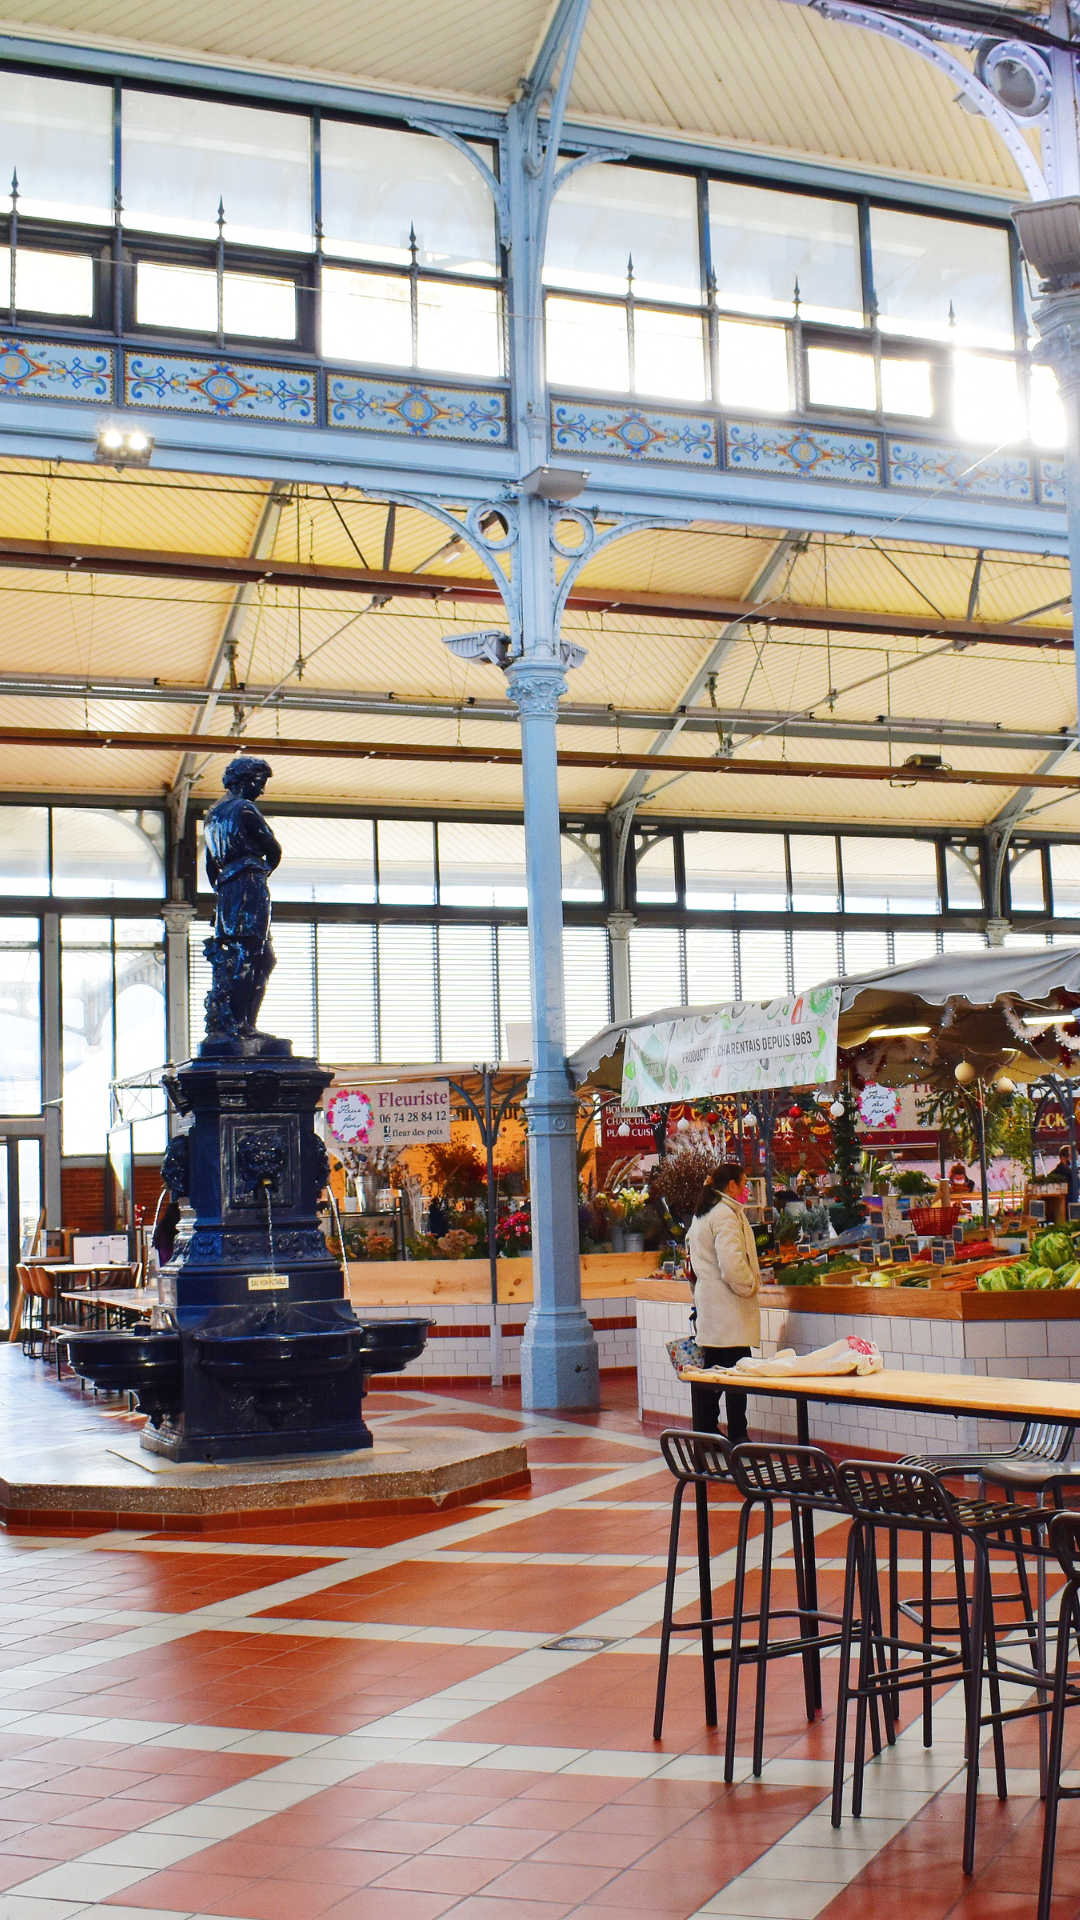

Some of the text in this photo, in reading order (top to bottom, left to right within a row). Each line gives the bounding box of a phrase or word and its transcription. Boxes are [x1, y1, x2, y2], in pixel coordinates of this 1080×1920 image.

[682, 1047, 717, 1064] PRODUCTEUR
[717, 1039, 761, 1057] CHARENTAIS
[762, 1034, 790, 1051] DEPUIS
[791, 1030, 812, 1046] 1963
[378, 1090, 448, 1108] Fleuriste
[380, 1113, 391, 1123] 06
[393, 1113, 405, 1123] 74
[407, 1112, 419, 1122] 28
[421, 1111, 433, 1121] 84
[436, 1110, 447, 1121] 12
[392, 1127, 443, 1137] fleur des pois
